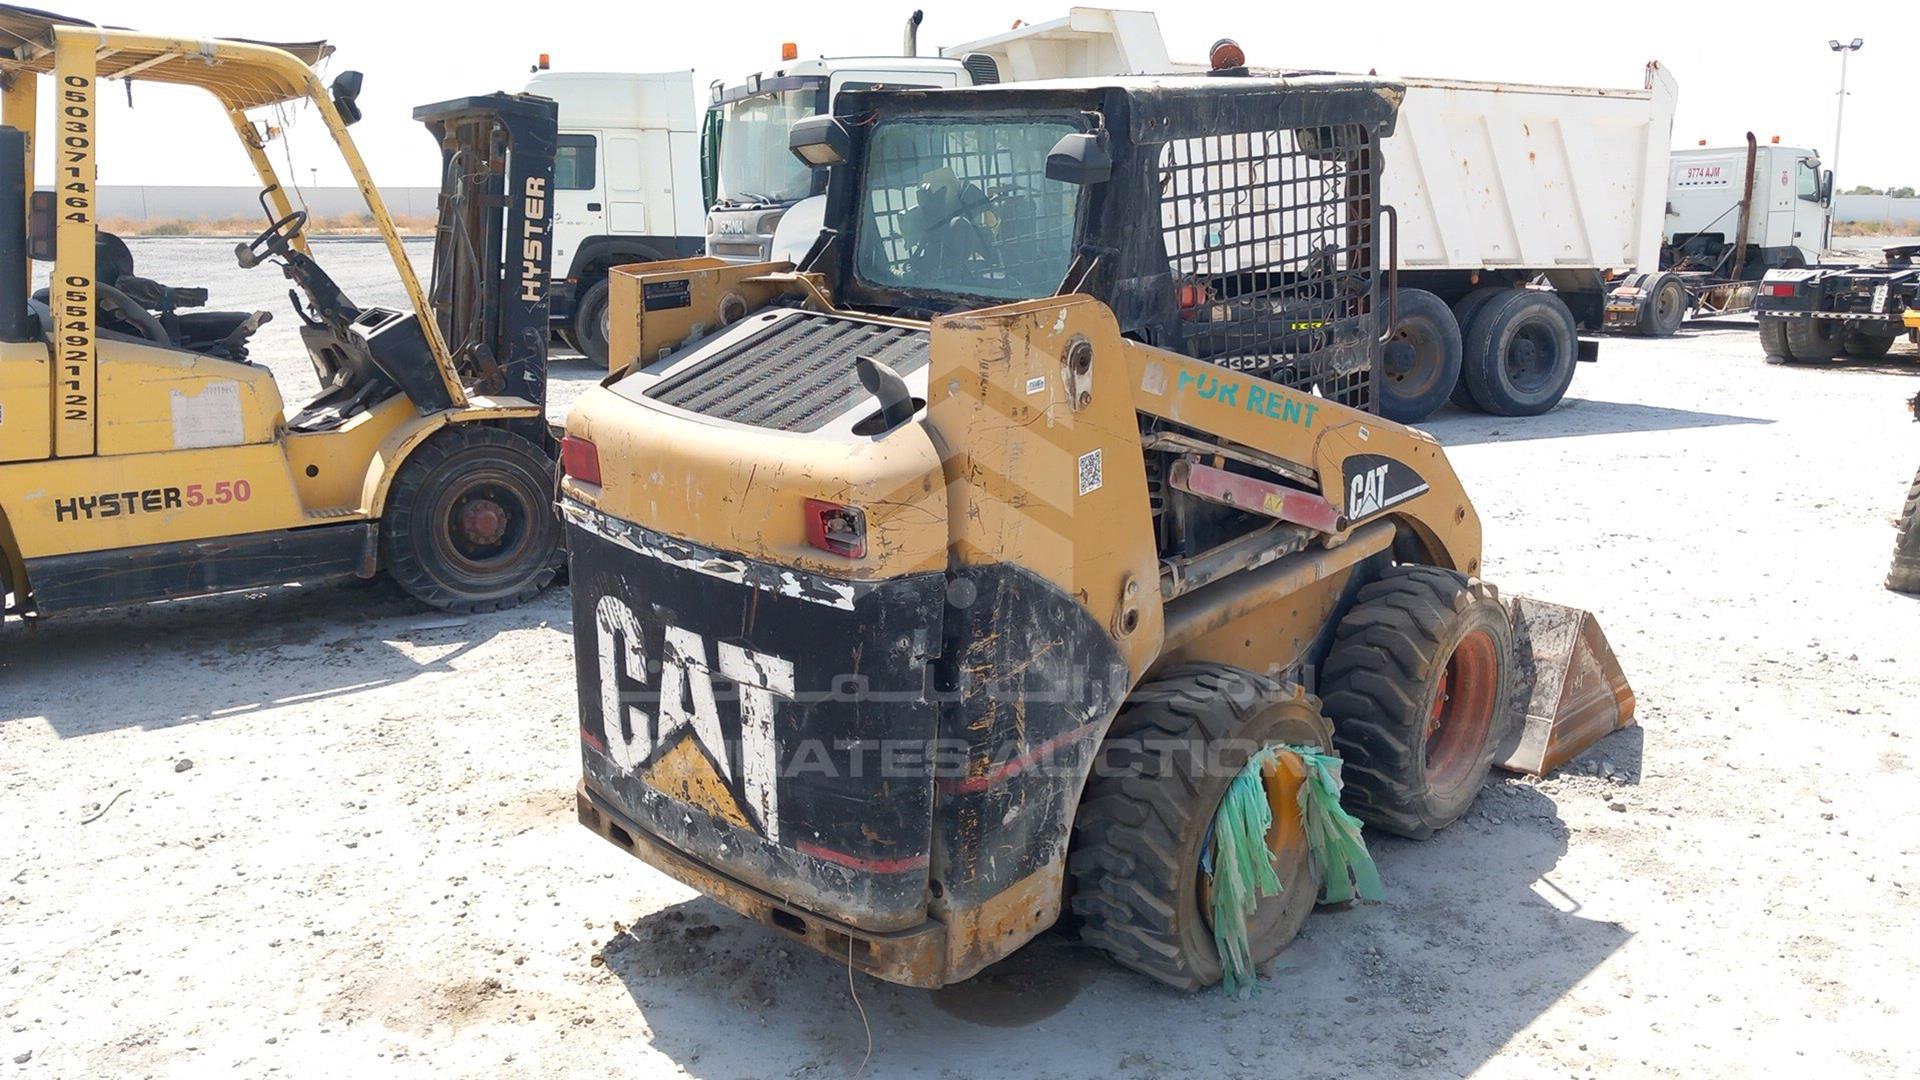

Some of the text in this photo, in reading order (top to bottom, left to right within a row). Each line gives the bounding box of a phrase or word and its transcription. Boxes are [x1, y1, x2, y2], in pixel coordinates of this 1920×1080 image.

[64, 76, 90, 223] 0503071464
[1687, 168, 1704, 178] 9774
[521, 176, 546, 302] HYSTER
[65, 276, 90, 420] 0554921122
[1246, 384, 1319, 429] RENT
[55, 479, 252, 522] HYSTER 5.50
[1350, 463, 1389, 521] CAT
[596, 595, 796, 844] CAT
